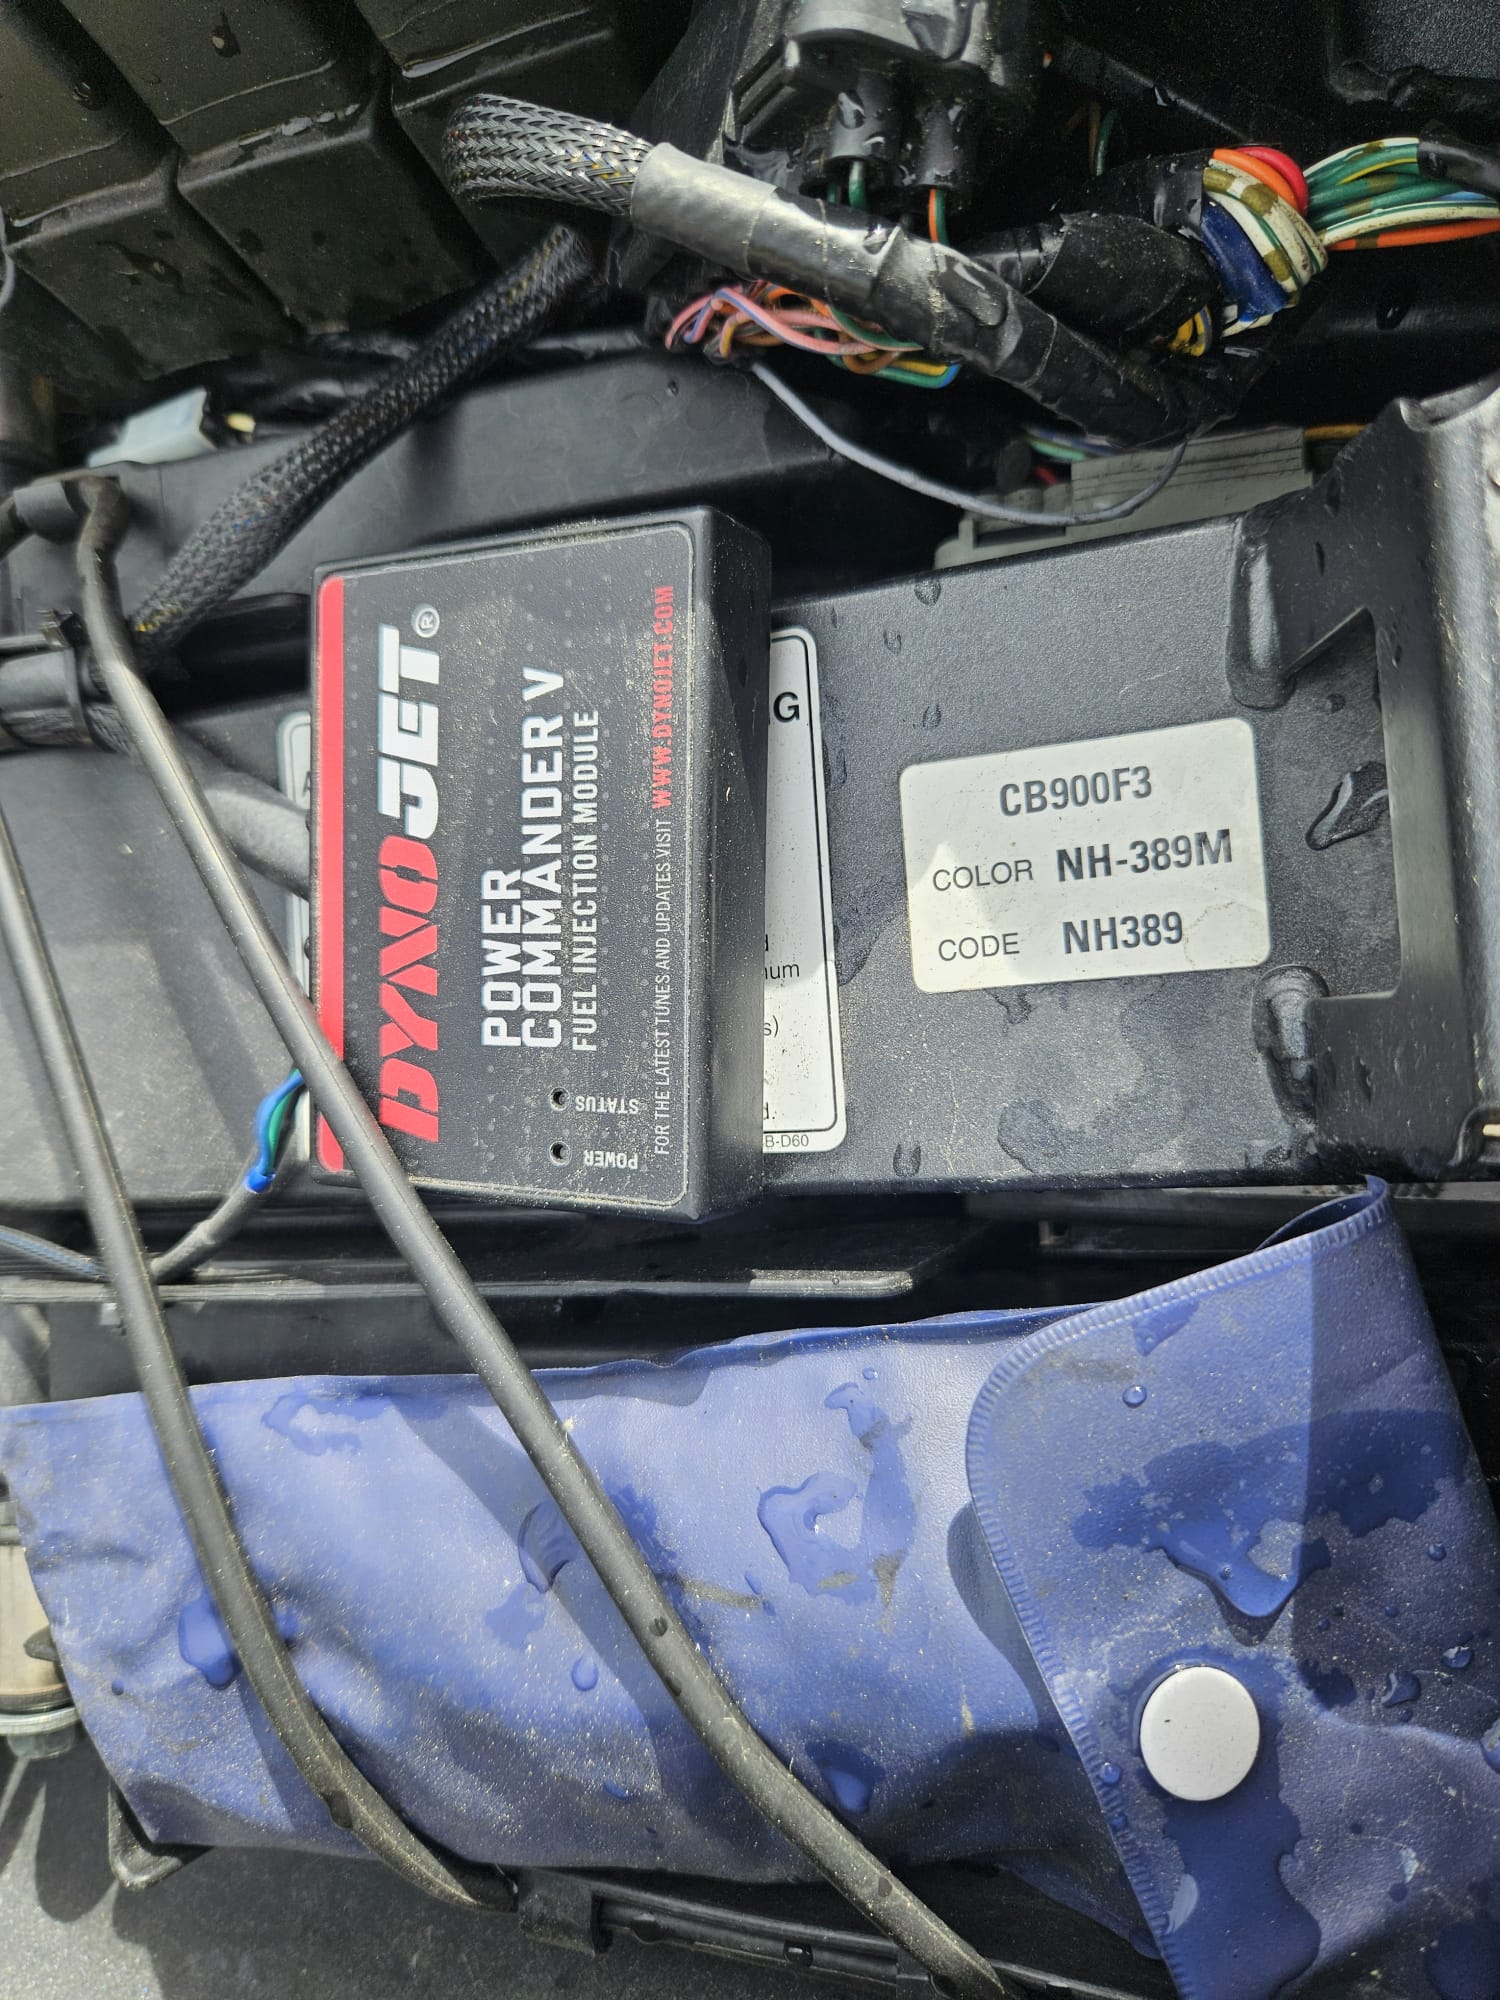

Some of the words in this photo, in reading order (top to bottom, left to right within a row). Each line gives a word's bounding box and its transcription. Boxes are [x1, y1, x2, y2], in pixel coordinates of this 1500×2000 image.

[522, 666, 564, 702] V
[652, 586, 674, 809] WWW.DYNOJET.COM
[572, 710, 599, 823] MODULE
[1000, 765, 1152, 817] CB900F3
[656, 819, 672, 858] VISIT
[933, 859, 1034, 892] COLOR
[1056, 829, 1233, 882] NH-389M
[378, 623, 440, 1143] DYNOJET
[522, 715, 563, 1048] COMMANDER
[572, 835, 598, 974] INJECTION
[656, 862, 671, 932] UPDATES
[481, 869, 521, 1047] POWER
[655, 938, 671, 970] AND
[938, 933, 1021, 961] CODE
[1063, 912, 1184, 955] NH389
[572, 984, 598, 1051] FUEL
[655, 974, 671, 1023] TUNES
[654, 1030, 670, 1086] LATEST
[575, 1095, 640, 1114] STATUS
[654, 1091, 670, 1120] THE
[583, 1149, 638, 1169] POWER
[654, 1125, 670, 1155] FOR
